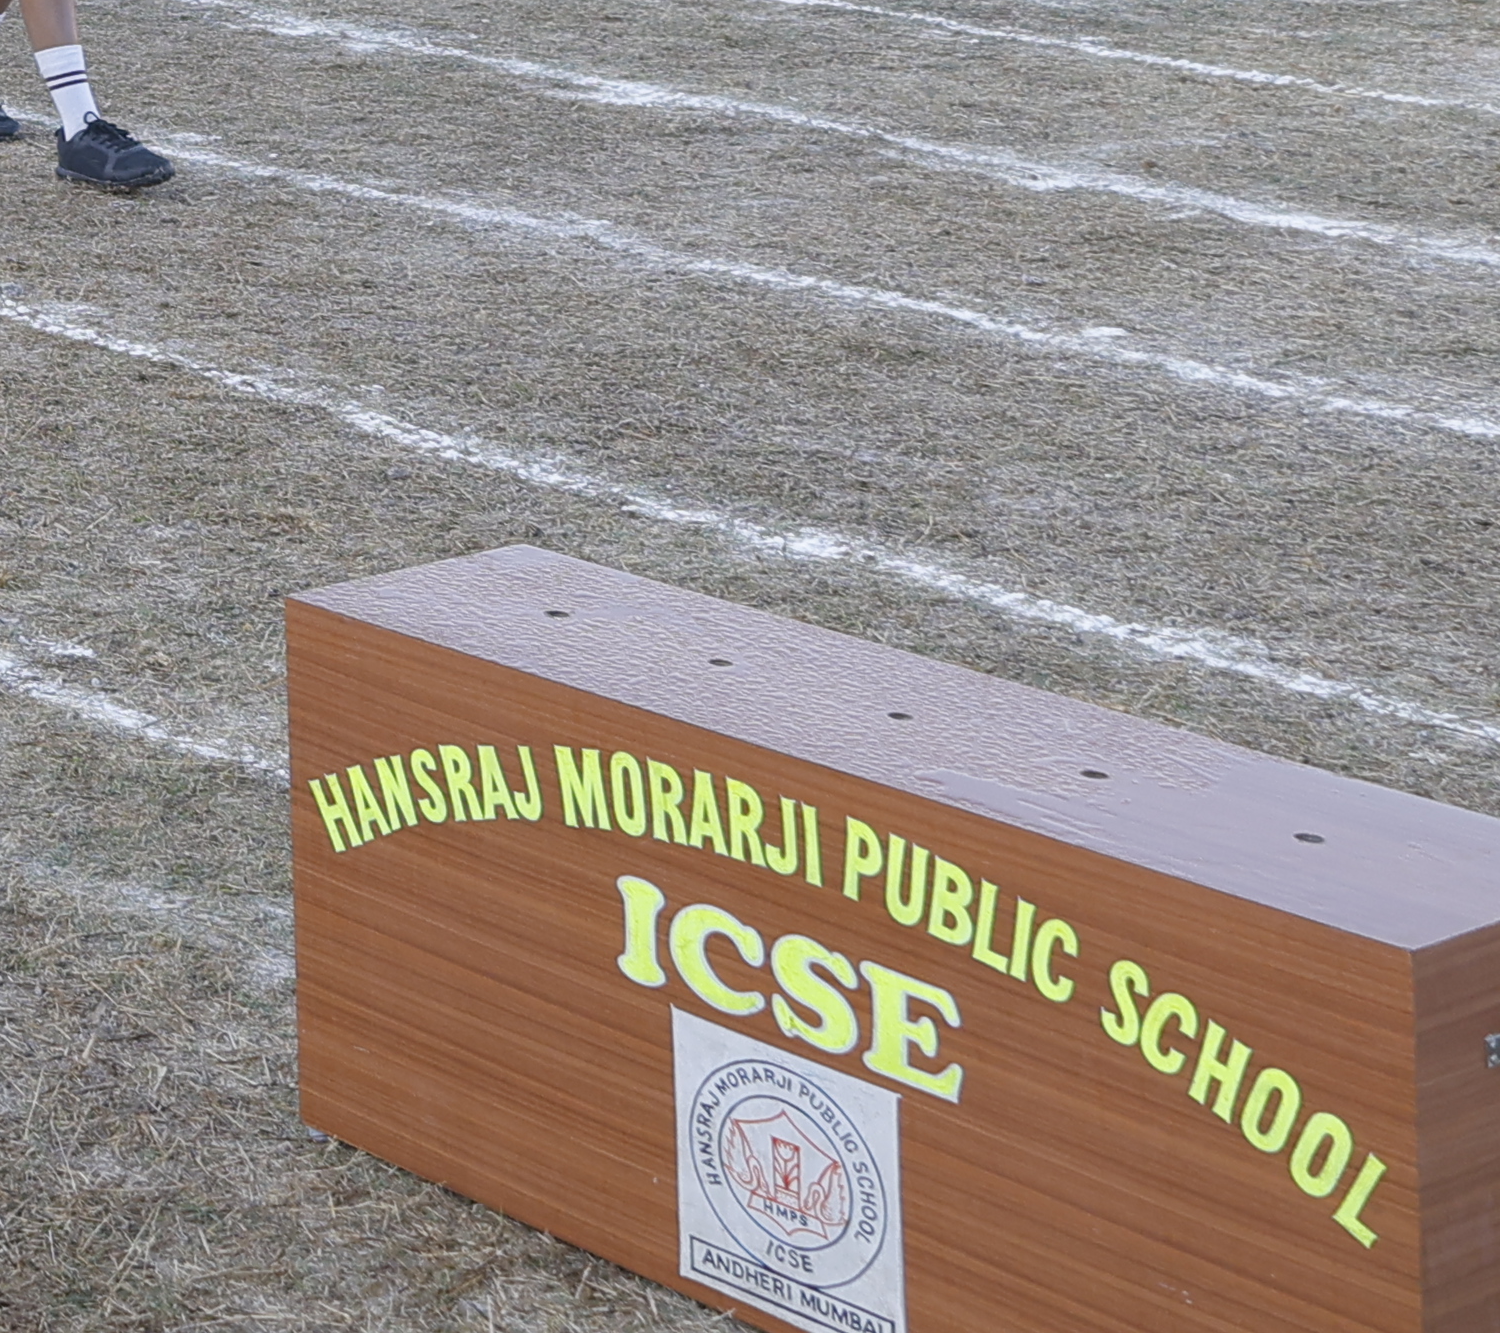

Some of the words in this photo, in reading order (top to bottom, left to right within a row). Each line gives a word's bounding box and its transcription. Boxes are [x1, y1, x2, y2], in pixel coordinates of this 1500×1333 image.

[308, 743, 543, 854] HANSRAJ
[554, 745, 823, 888] MORARJI
[843, 815, 1080, 1005] PUBLIC
[1101, 959, 1391, 1250] SCHOOL
[615, 875, 965, 1104] ICSE
[695, 1091, 723, 1186] HANSRAJ
[717, 1067, 793, 1095] MORARJI
[852, 1160, 878, 1245] SCHOOL
[763, 1195, 810, 1228] HMPS
[702, 1248, 793, 1301] ANDHERI
[799, 1288, 888, 1333] MUMBAI
[765, 1239, 814, 1274] ICSE
